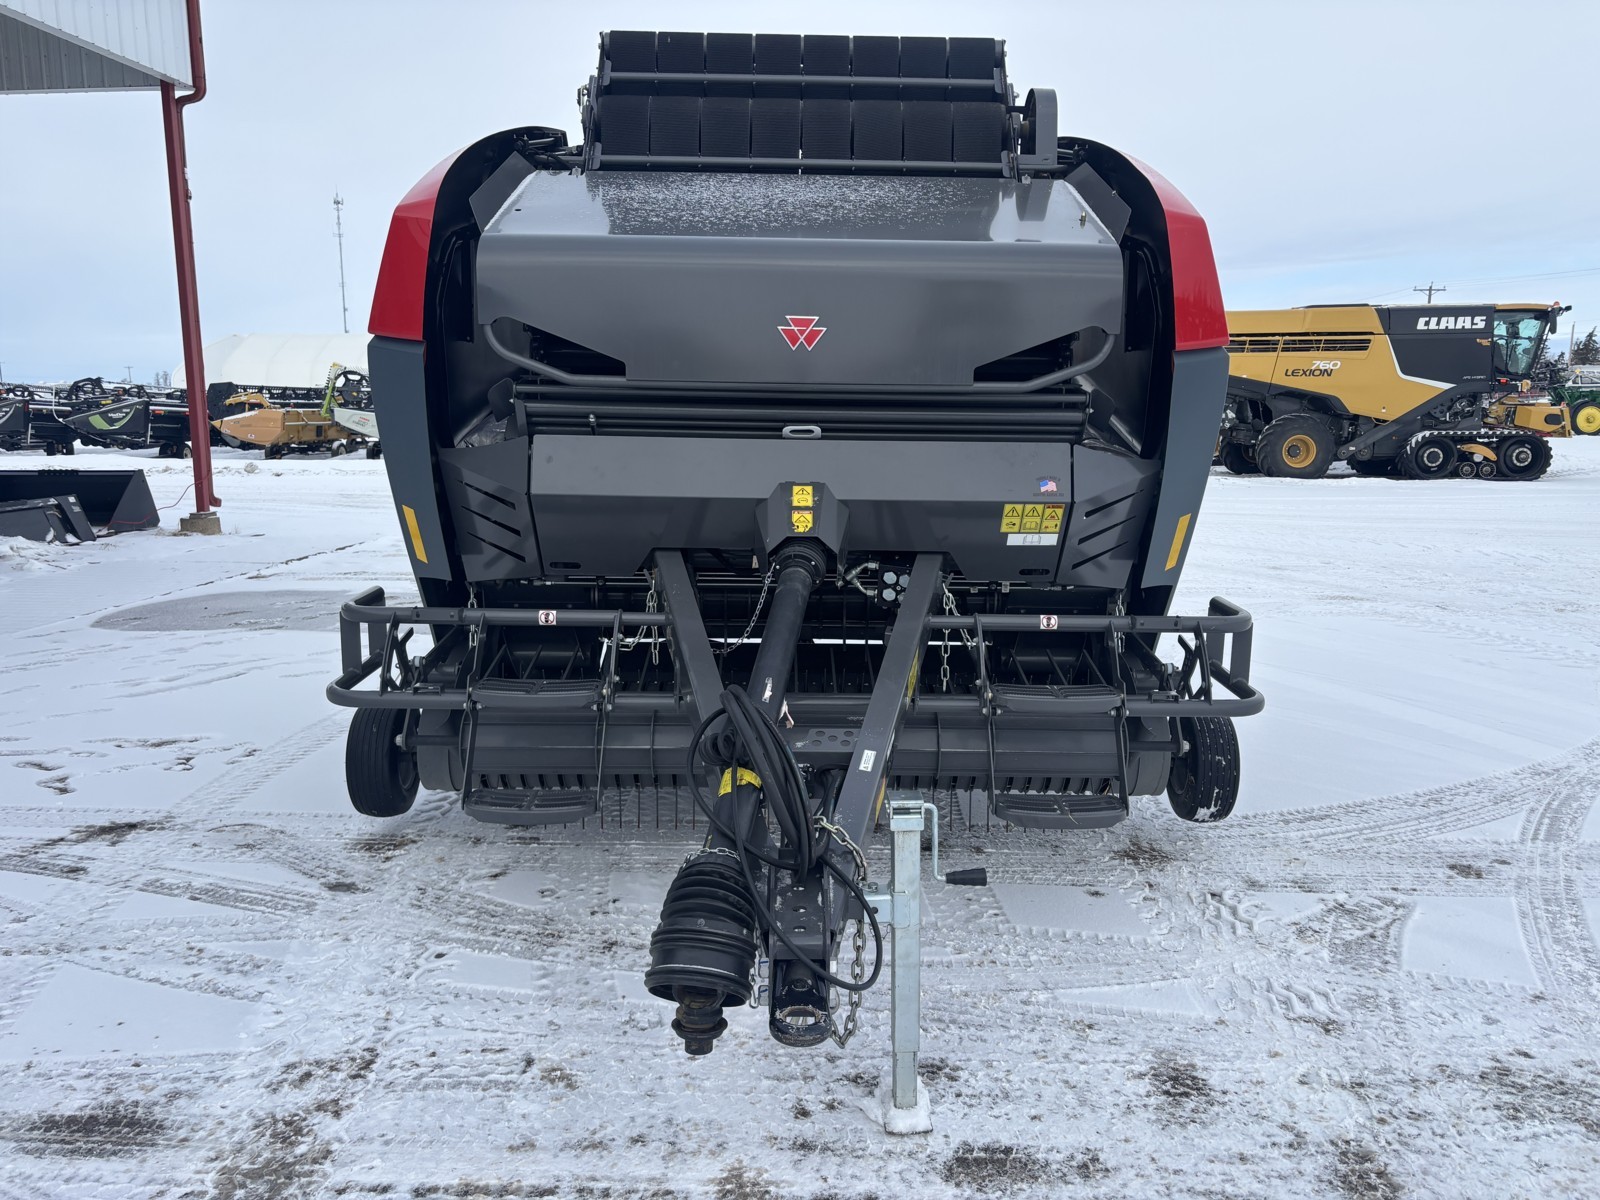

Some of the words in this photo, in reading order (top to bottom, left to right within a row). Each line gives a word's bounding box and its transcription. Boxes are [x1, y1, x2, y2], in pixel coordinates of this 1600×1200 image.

[1416, 316, 1487, 330] CLAAS
[1311, 360, 1341, 369] 760
[1284, 368, 1334, 377] LEXION
